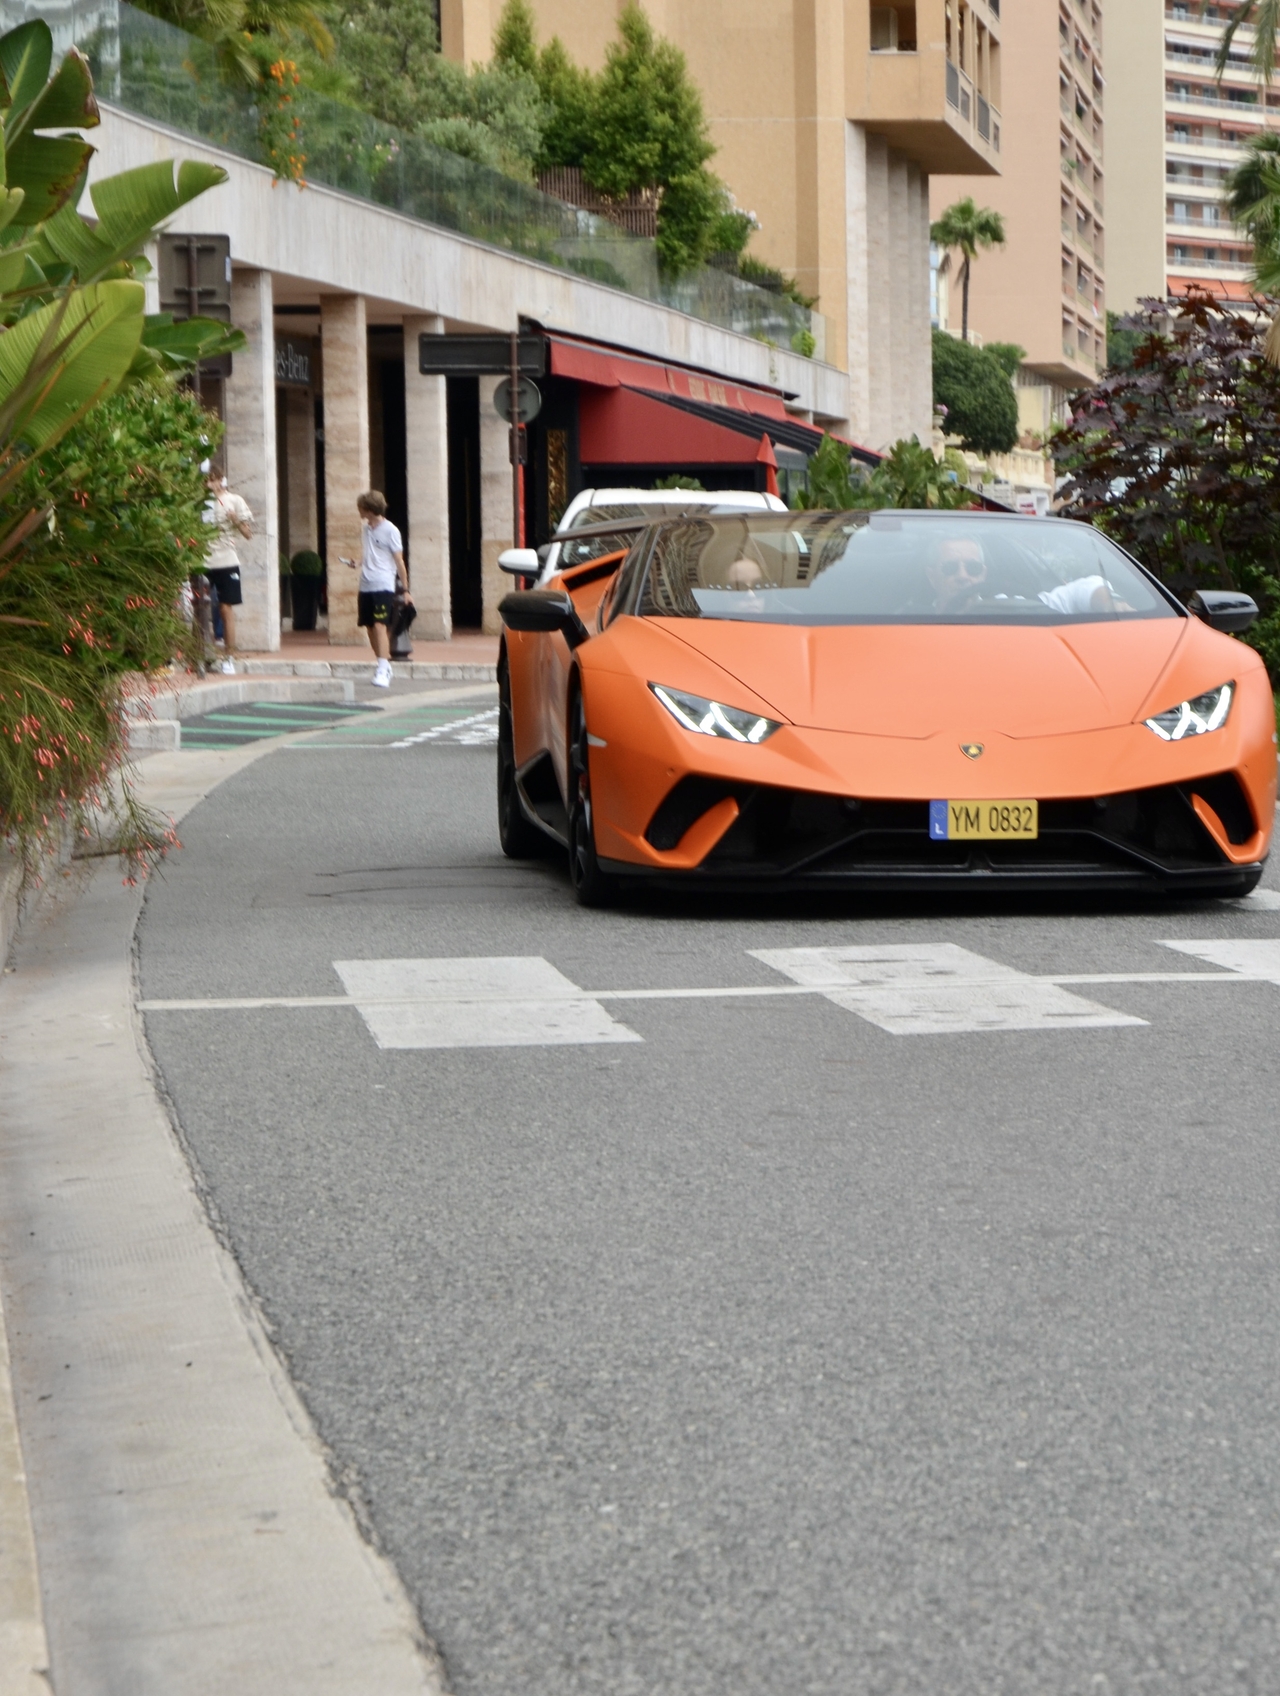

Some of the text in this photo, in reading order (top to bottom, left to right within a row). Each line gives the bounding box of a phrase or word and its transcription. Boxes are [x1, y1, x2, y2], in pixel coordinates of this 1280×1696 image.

[934, 822, 944, 835] L
[951, 806, 1033, 832] YM 0832
